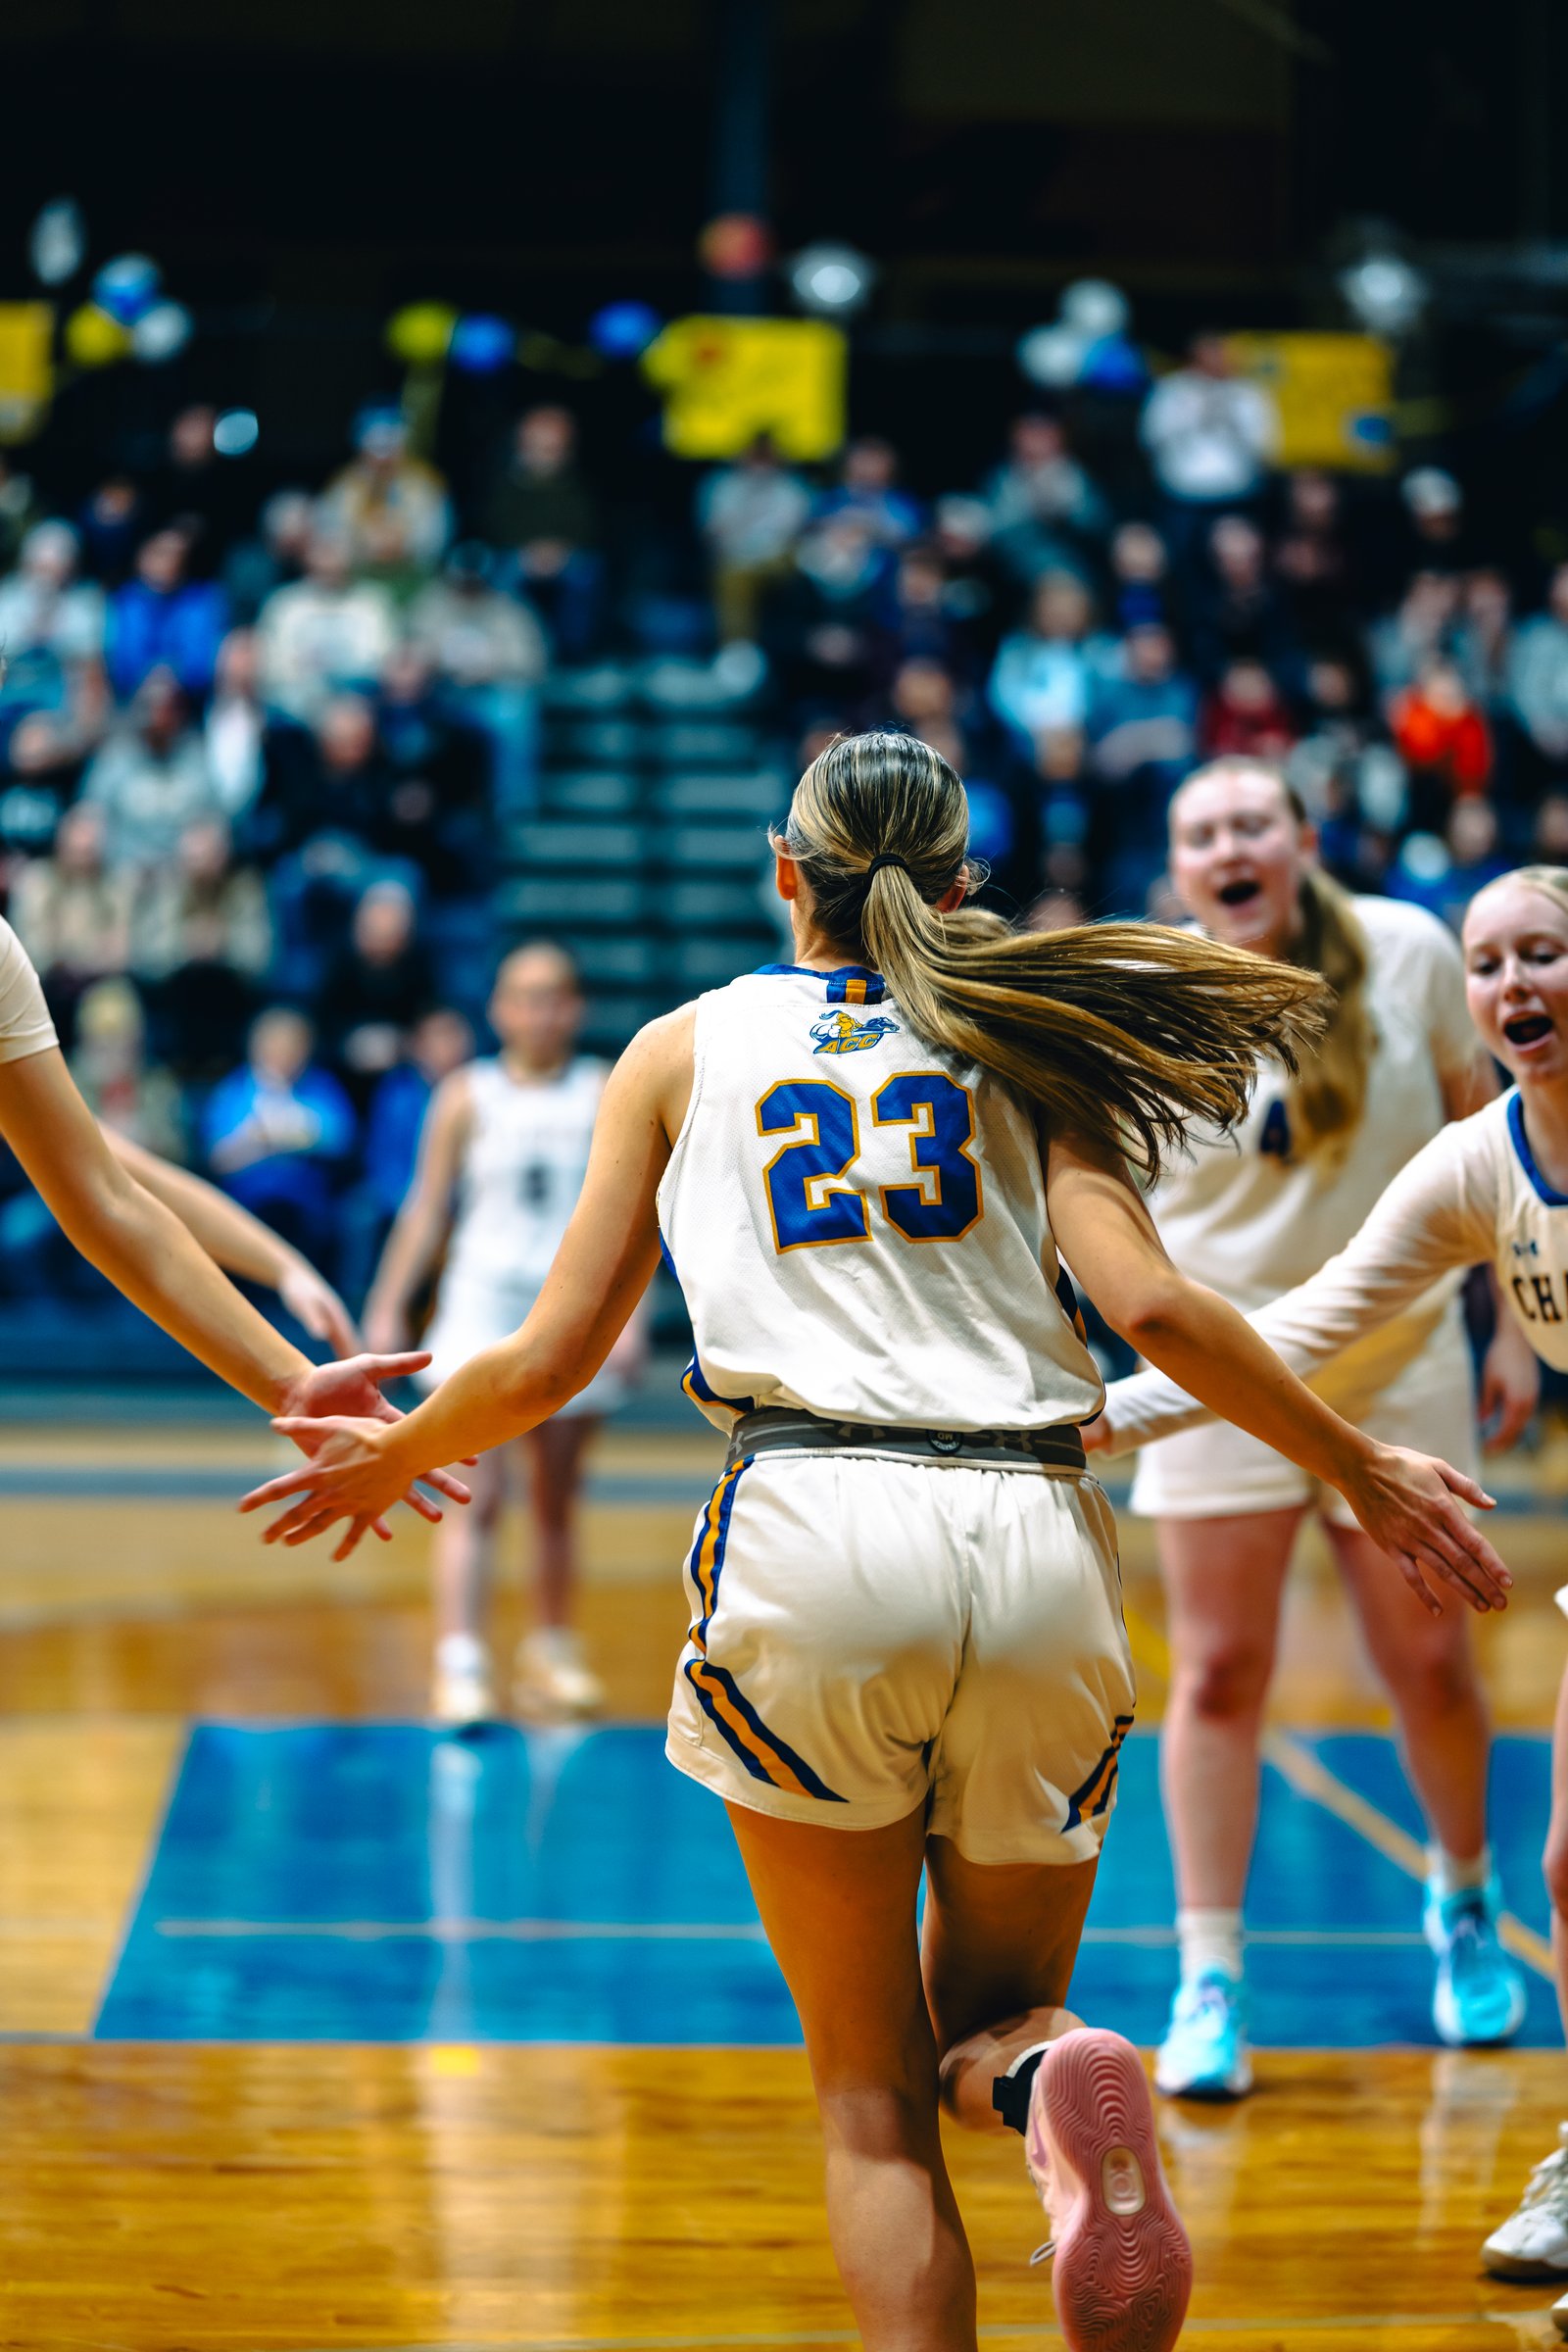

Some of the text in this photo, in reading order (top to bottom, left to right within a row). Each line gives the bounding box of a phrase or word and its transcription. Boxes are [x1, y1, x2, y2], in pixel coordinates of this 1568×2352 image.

[818, 1033, 879, 1054] ACC
[755, 1071, 984, 1254] 23
[1512, 1271, 1568, 1323] CH
